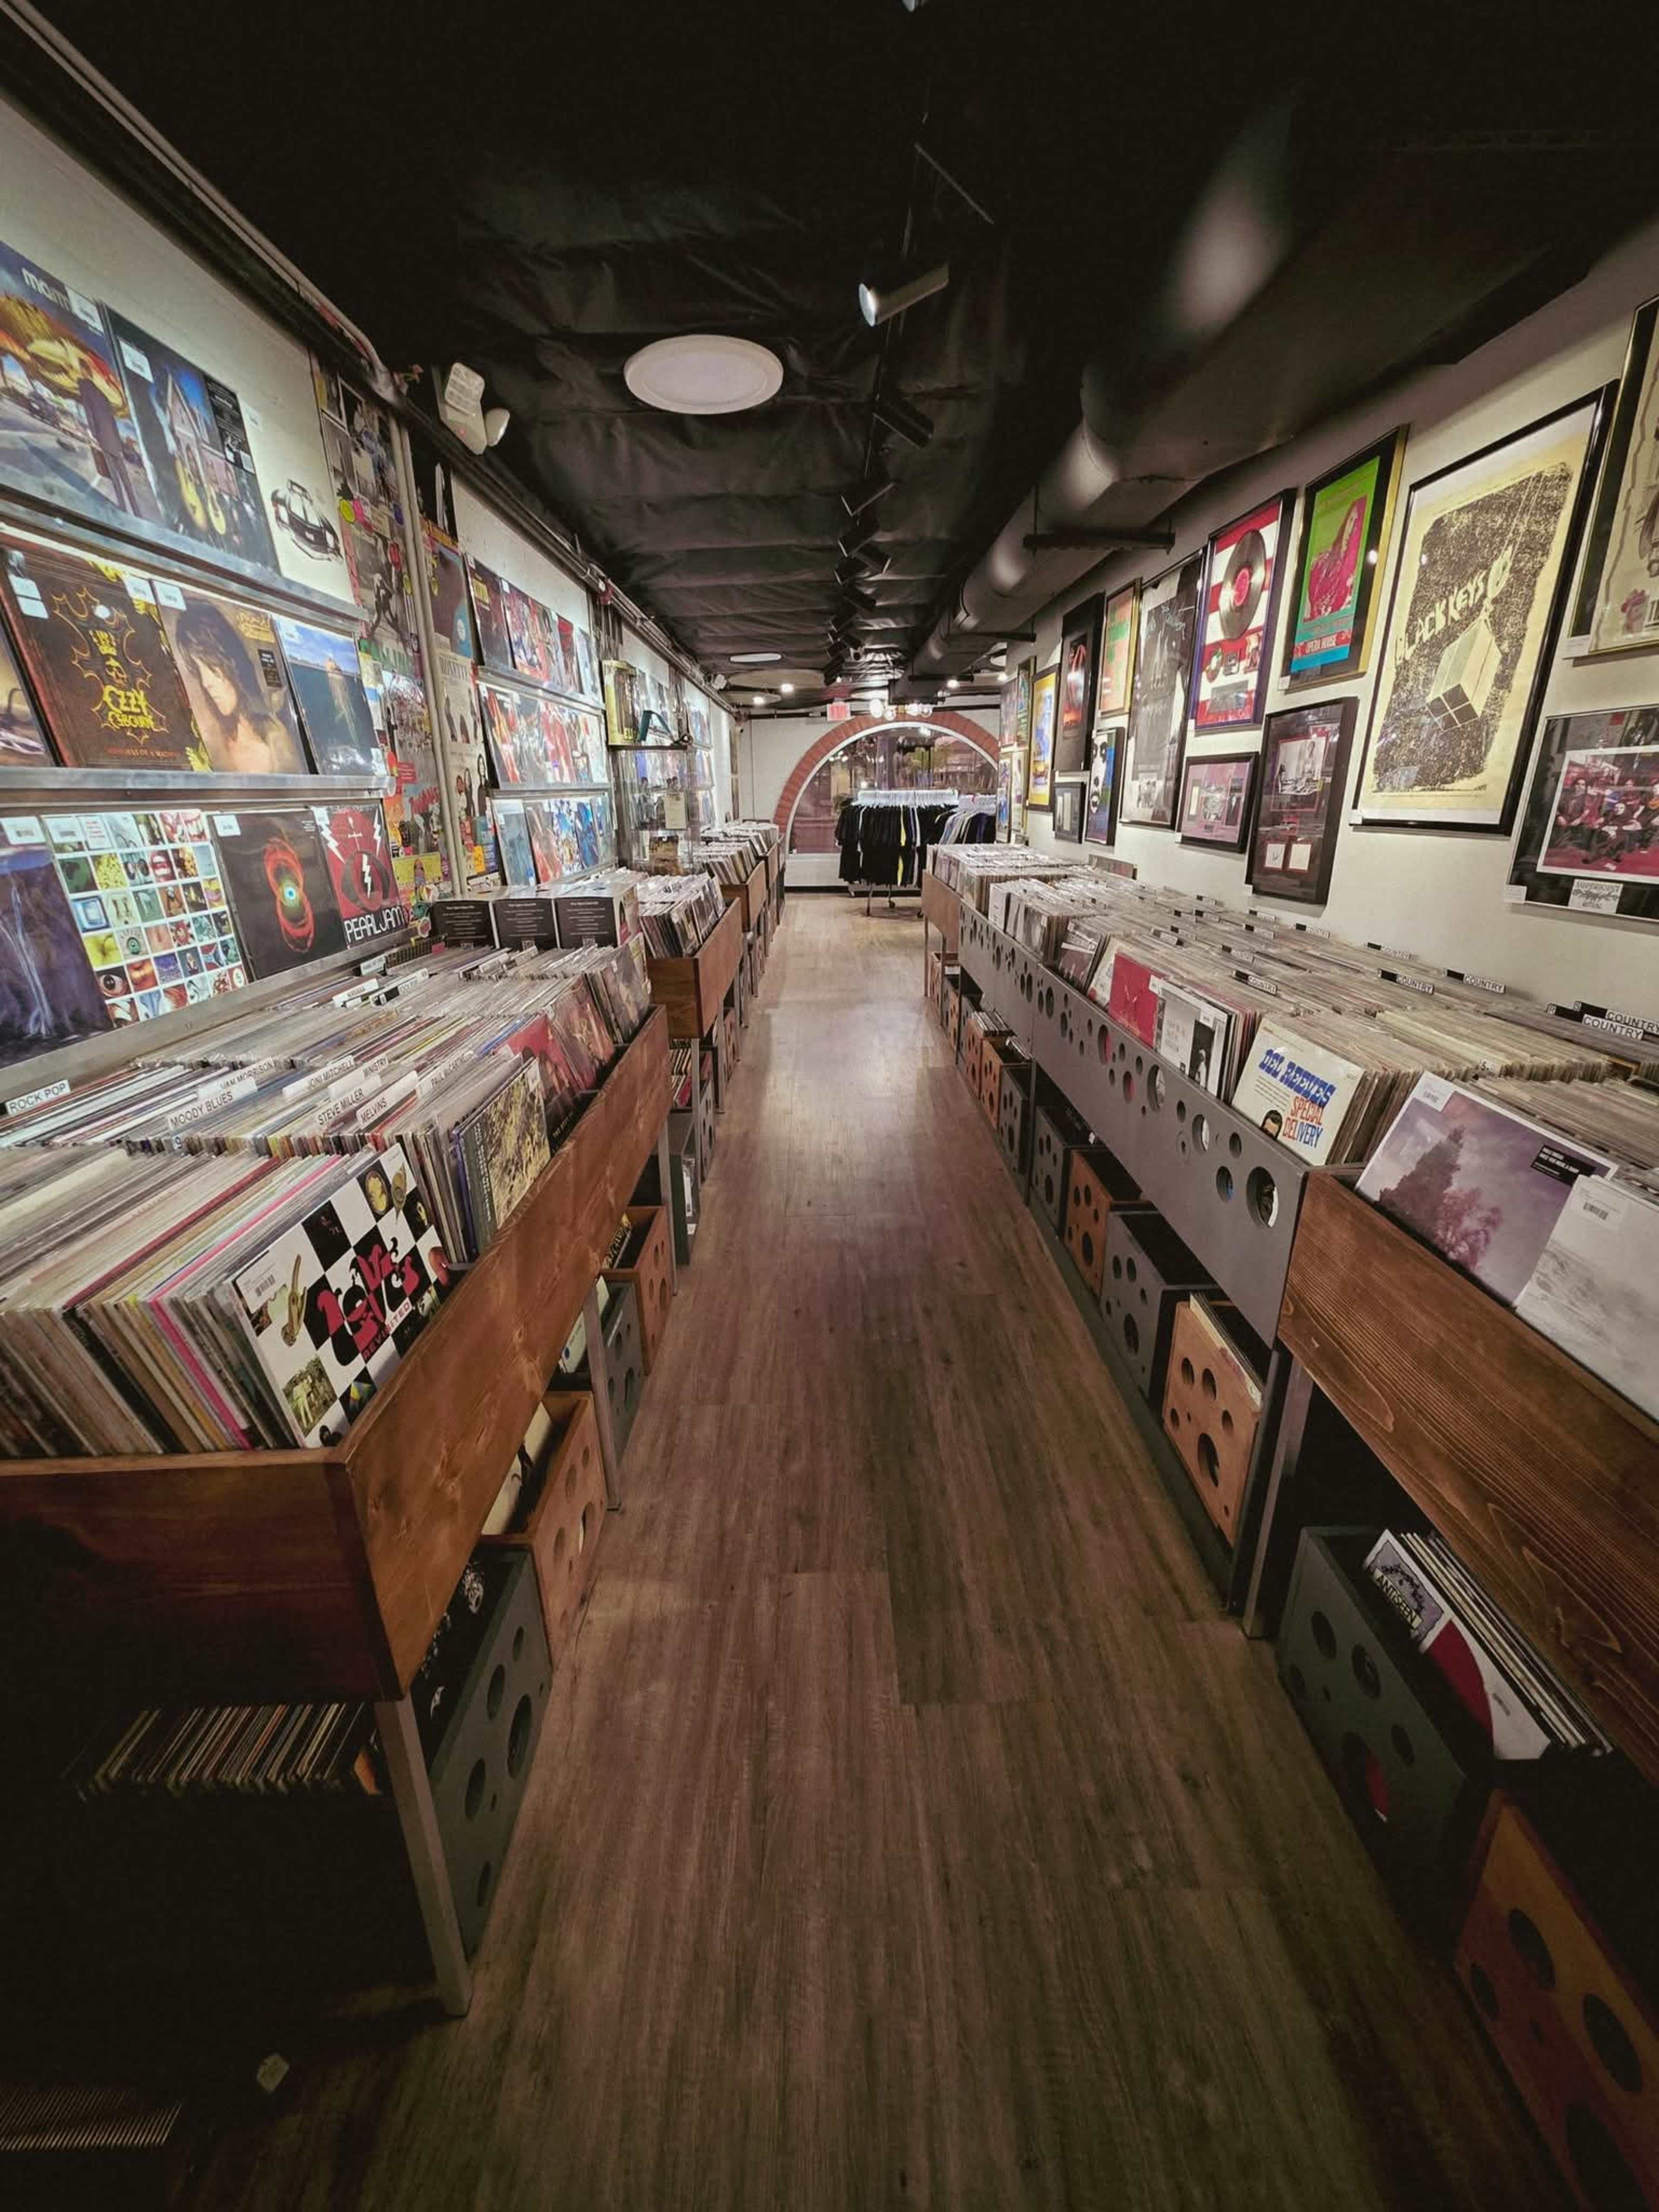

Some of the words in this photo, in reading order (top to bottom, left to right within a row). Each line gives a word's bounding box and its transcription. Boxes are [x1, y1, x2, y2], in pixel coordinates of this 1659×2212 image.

[1448, 570, 1487, 626] KEYS
[344, 913, 381, 943] PEARL
[379, 906, 405, 931] JAM
[1398, 976, 1433, 994] COUNTRY
[1465, 975, 1503, 994] COUNTRY
[1583, 1016, 1642, 1039] COUNTRY
[1607, 1011, 1659, 1033] COUNTRY
[1259, 1049, 1285, 1079] DEL
[1279, 1061, 1337, 1108] REEVES
[9, 1092, 42, 1112] ROCK
[44, 1082, 66, 1098] POP
[170, 1105, 203, 1127] MOODY
[206, 1091, 233, 1112] BLUES
[318, 1104, 341, 1125] STEVE
[340, 1088, 364, 1107] MILLER
[361, 1097, 387, 1123] MELVINS
[1290, 1096, 1325, 1126] SPECIAL
[1282, 1117, 1323, 1148] DELIVERY
[361, 1300, 410, 1361] REVISITED
